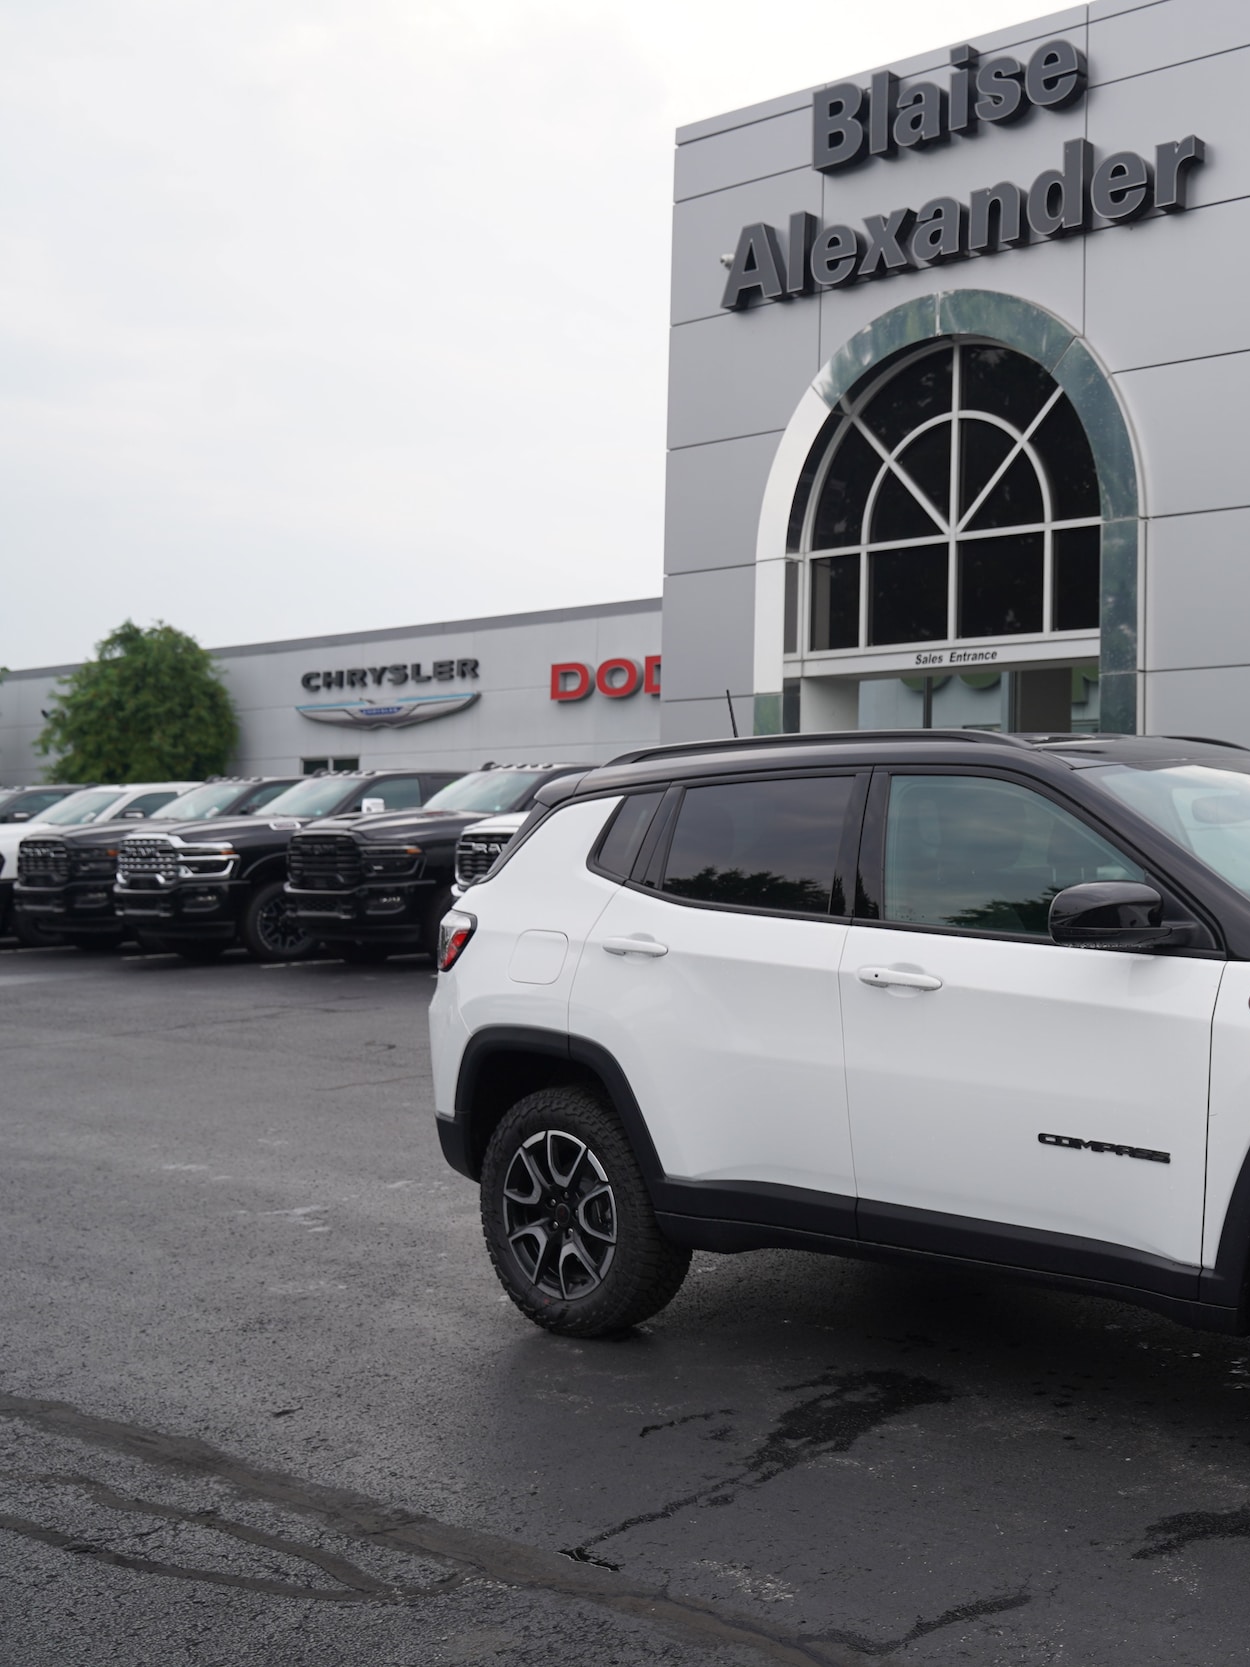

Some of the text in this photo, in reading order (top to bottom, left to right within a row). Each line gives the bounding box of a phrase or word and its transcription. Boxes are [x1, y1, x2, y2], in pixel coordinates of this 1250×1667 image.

[813, 39, 1088, 174] Blaise
[721, 134, 1205, 312] Alexander
[915, 650, 998, 665] Sales Entrance
[301, 658, 480, 693] CHRYSLER
[1037, 1132, 1171, 1165] COMPASS
